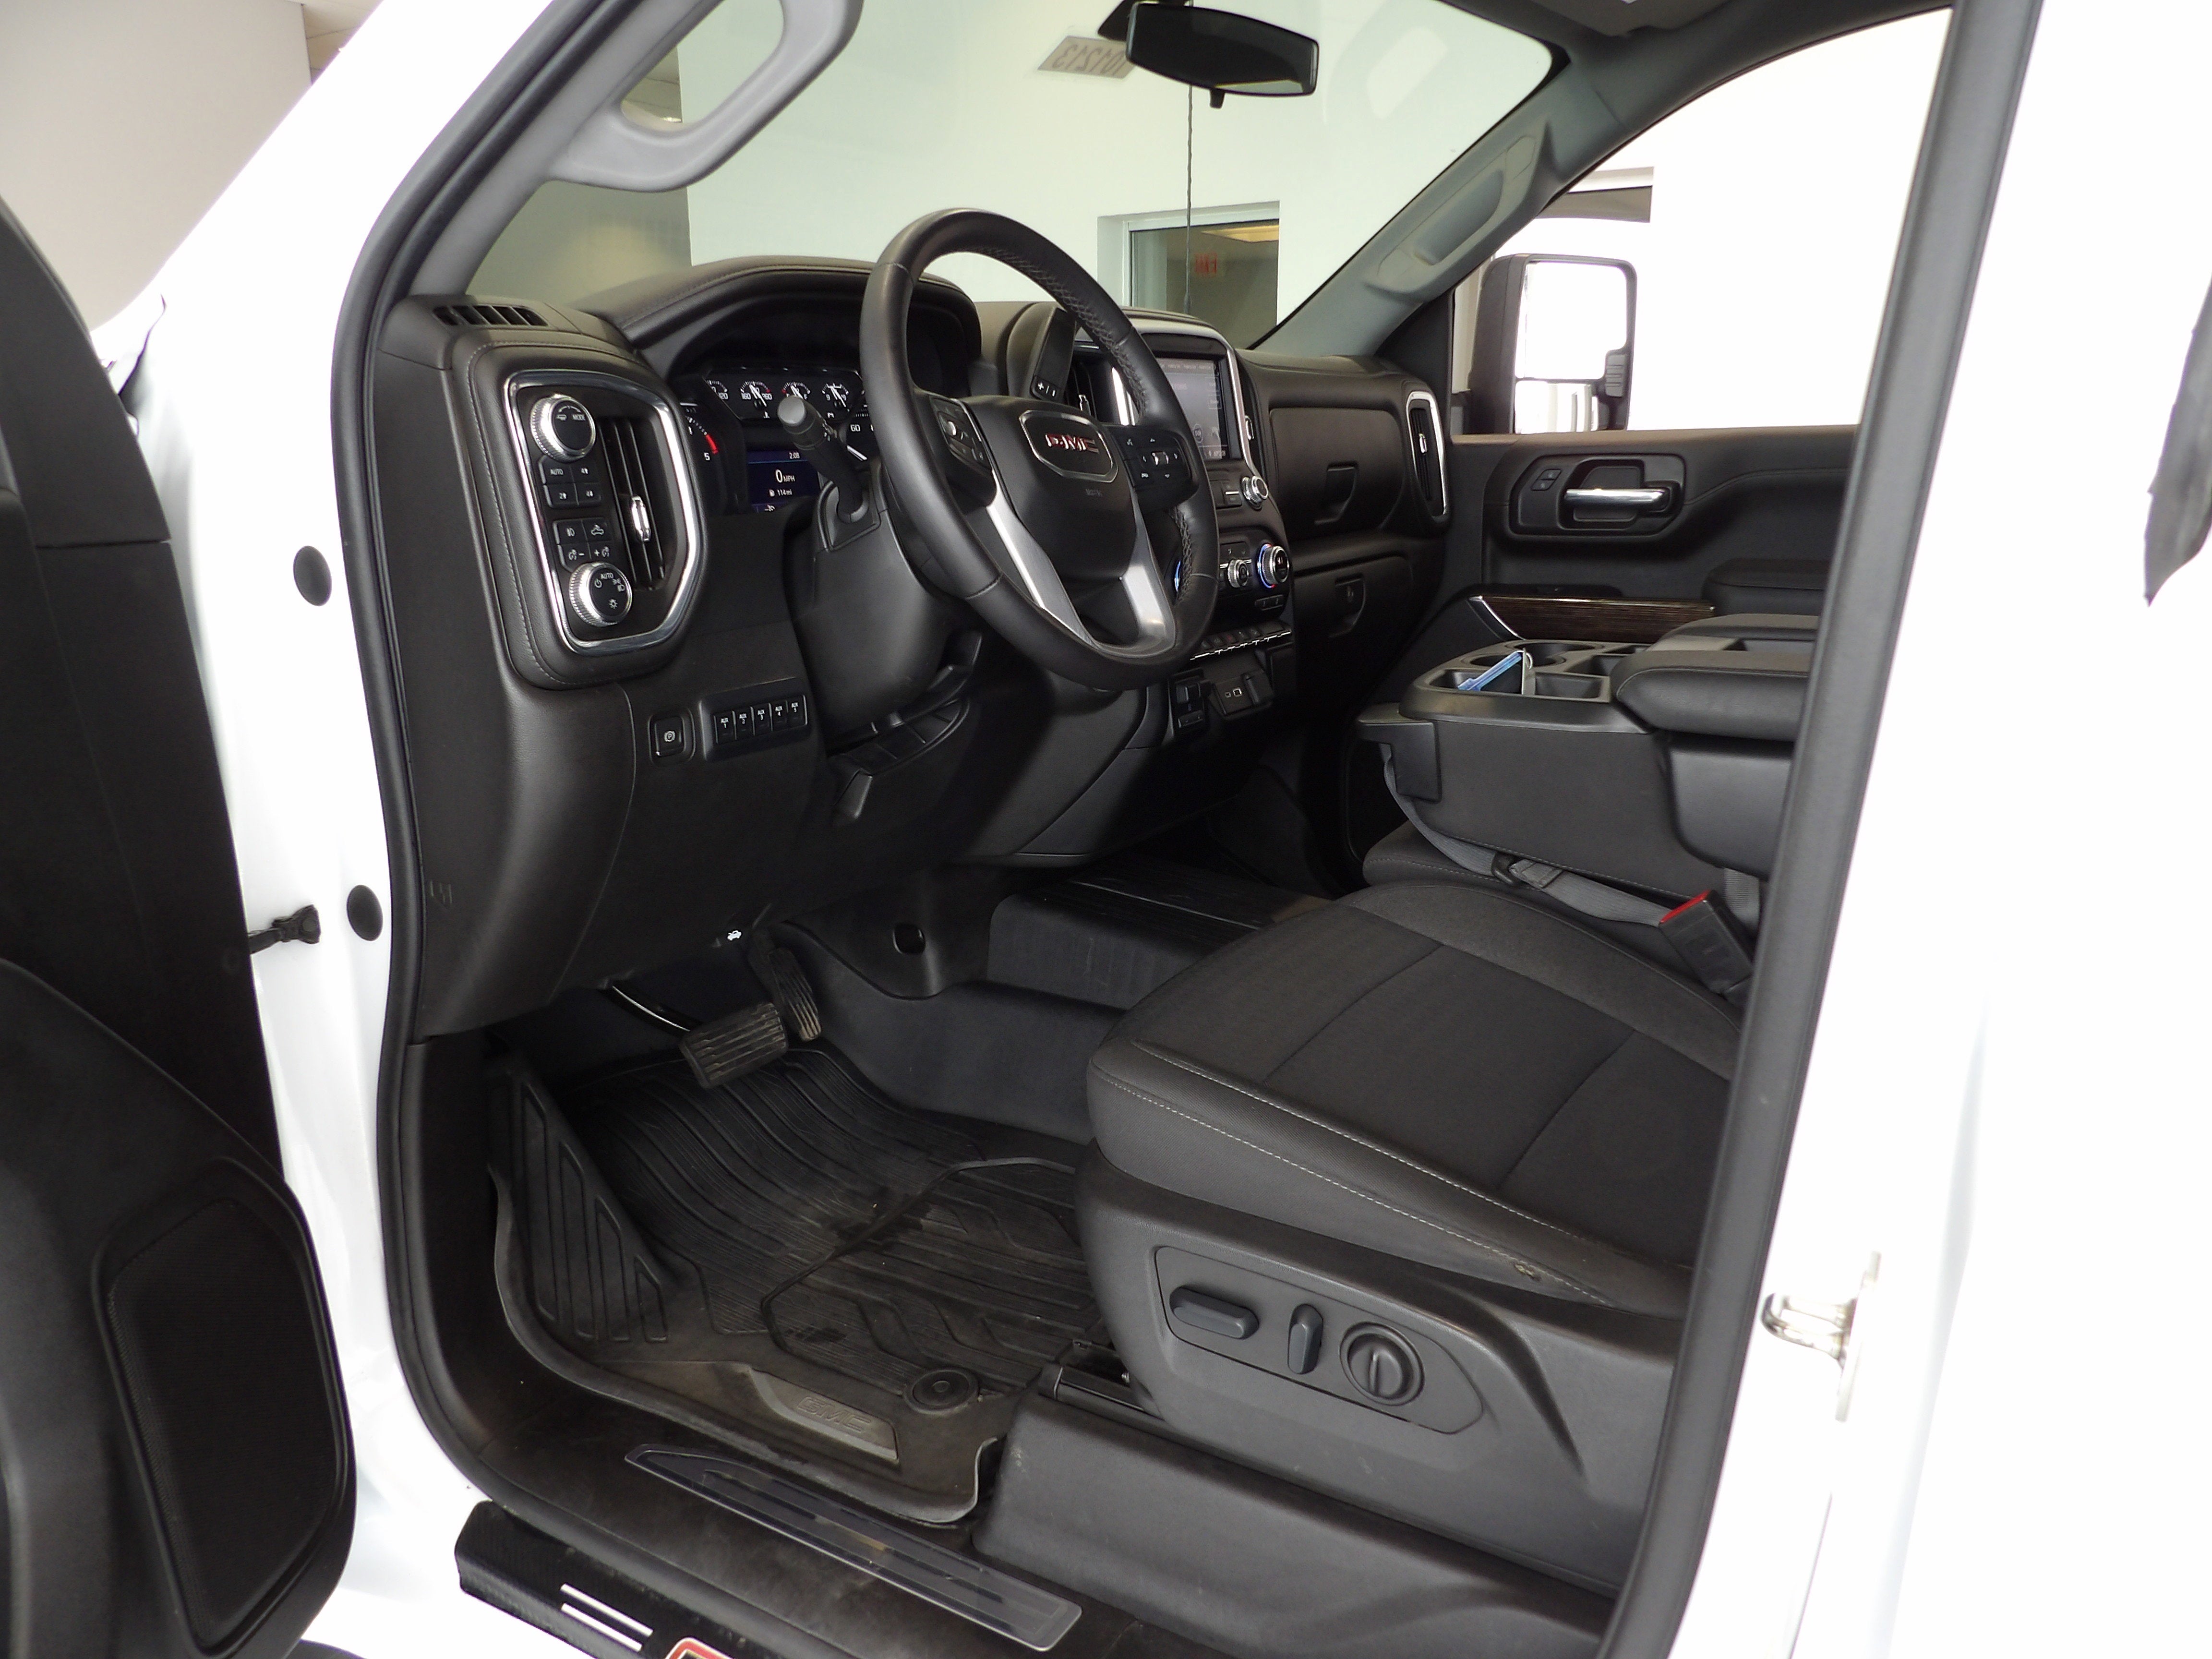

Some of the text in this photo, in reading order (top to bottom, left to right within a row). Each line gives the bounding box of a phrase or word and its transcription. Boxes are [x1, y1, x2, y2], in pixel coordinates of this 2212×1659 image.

[572, 413, 586, 421] MODE
[850, 424, 861, 432] 60
[704, 453, 710, 461] 5
[775, 469, 783, 483] 0
[797, 1395, 872, 1434] GMC
